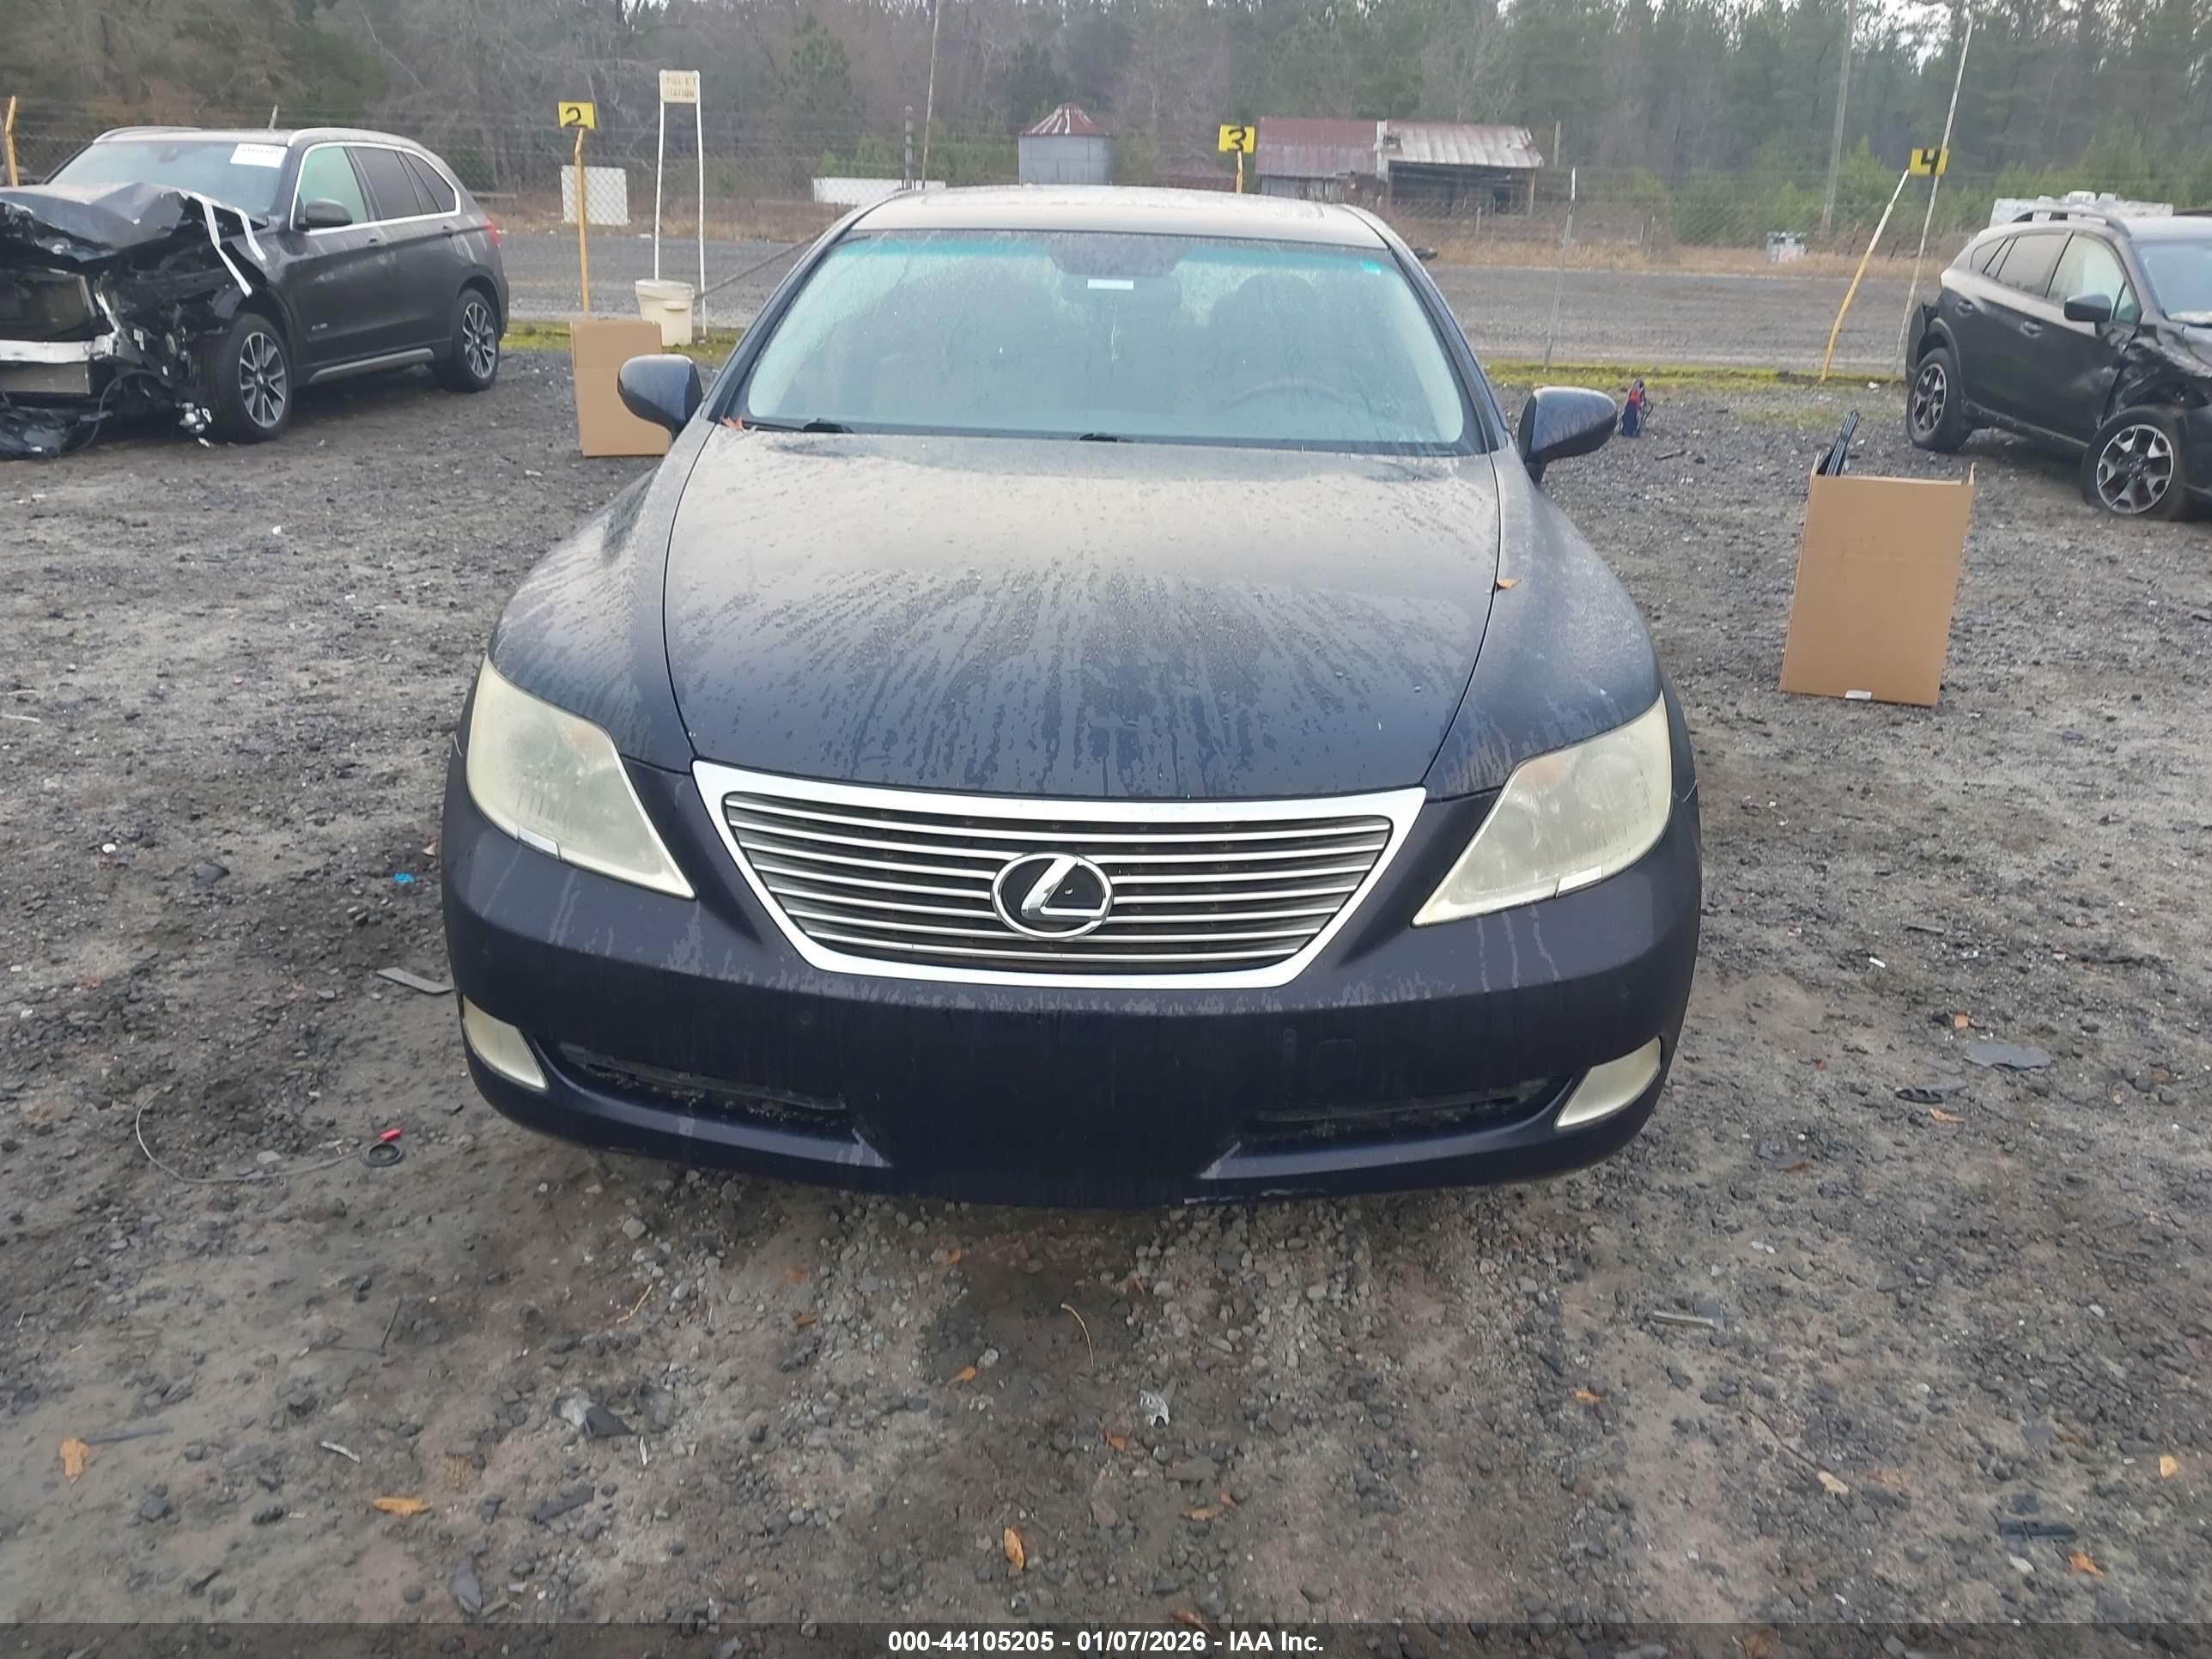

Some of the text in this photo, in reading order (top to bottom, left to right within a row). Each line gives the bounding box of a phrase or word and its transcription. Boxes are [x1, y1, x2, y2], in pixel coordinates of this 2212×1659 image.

[564, 106, 587, 128] 2
[1228, 125, 1247, 152] 3
[1921, 149, 1942, 173] 4
